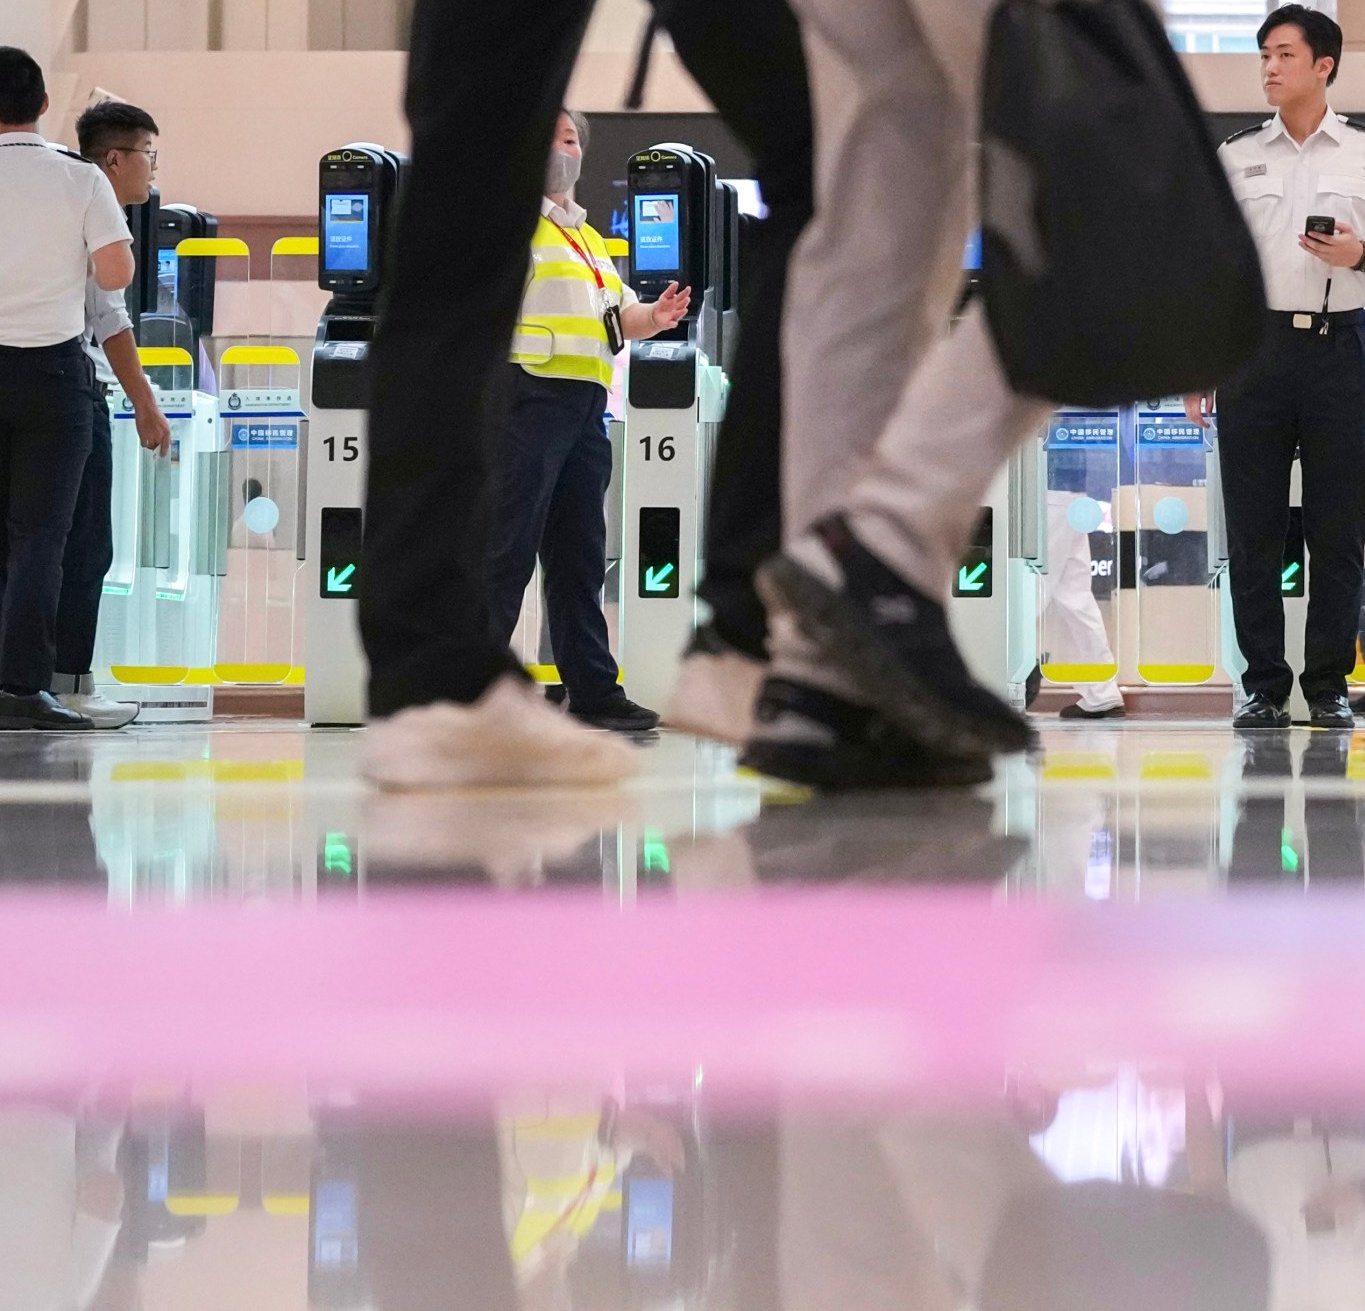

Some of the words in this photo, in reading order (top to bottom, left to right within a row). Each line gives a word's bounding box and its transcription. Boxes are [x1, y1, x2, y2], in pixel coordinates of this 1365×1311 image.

[1070, 428, 1114, 436] 中国移民管理
[1156, 428, 1200, 436] 中国移民管理
[323, 436, 359, 462] 15
[639, 435, 676, 462] 16
